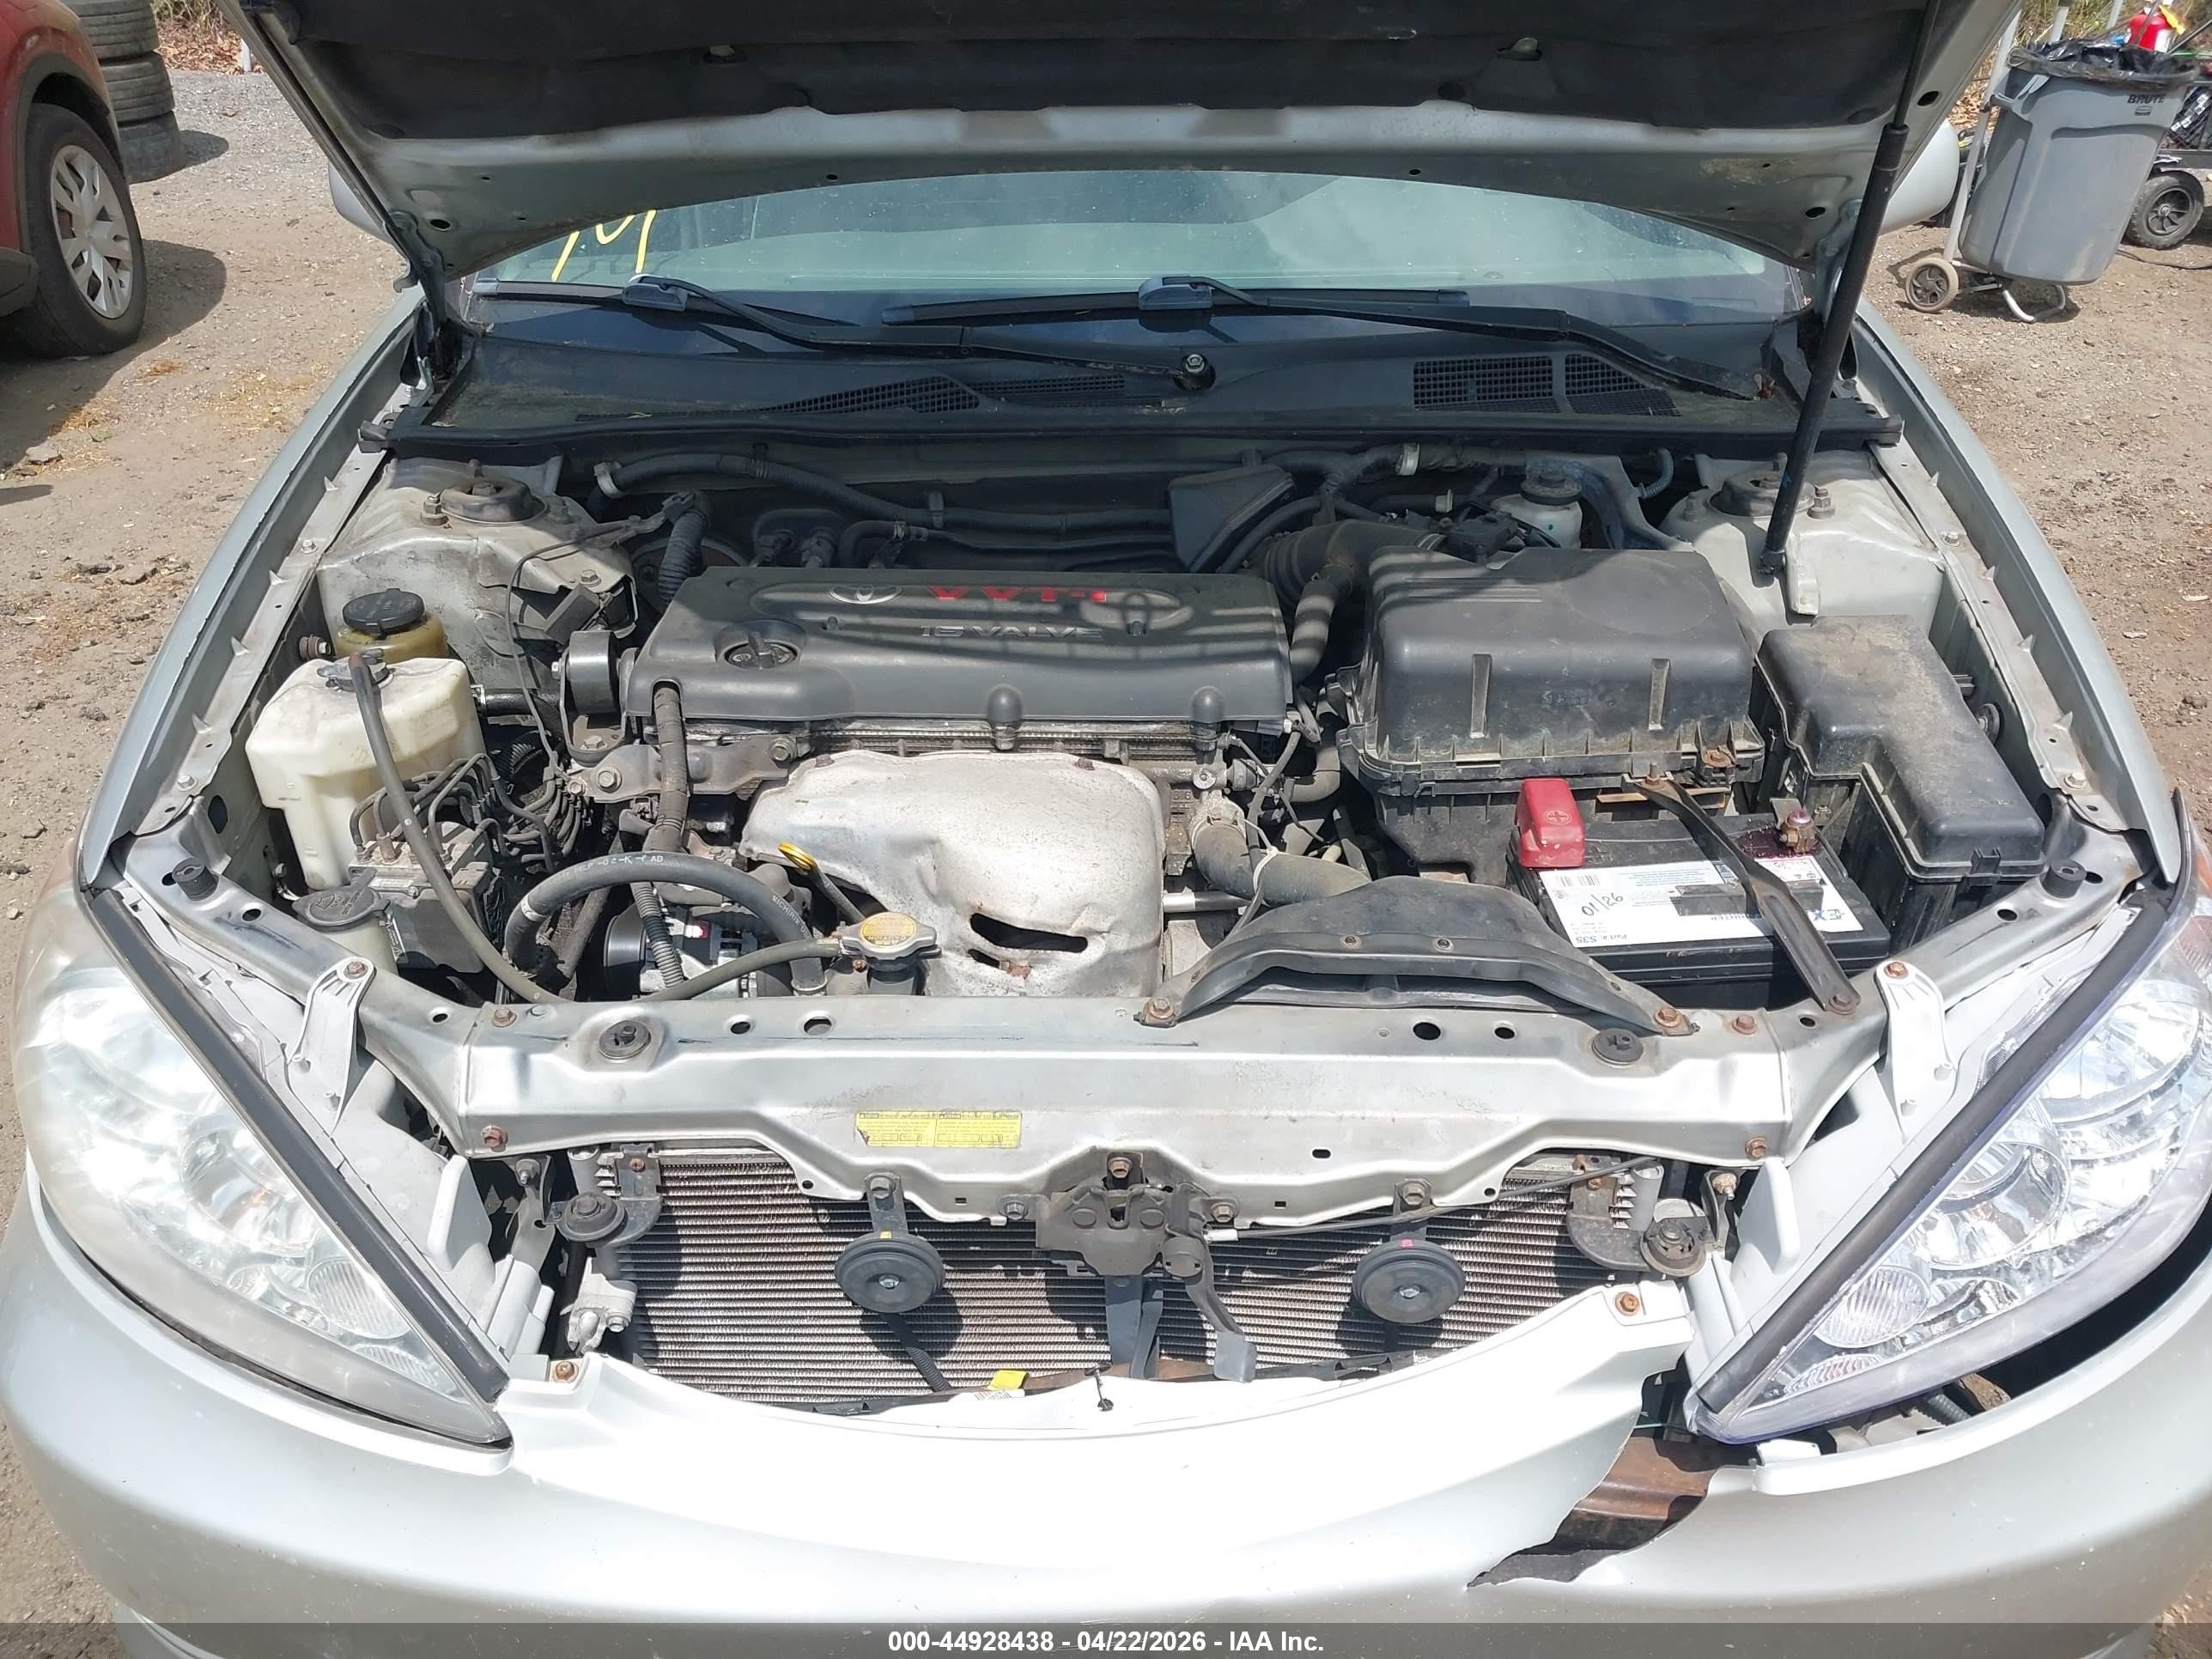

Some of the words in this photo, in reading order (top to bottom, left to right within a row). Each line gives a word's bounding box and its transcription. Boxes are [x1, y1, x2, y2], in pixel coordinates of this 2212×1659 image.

[2127, 94, 2165, 104] BRUTE
[972, 625, 1103, 638] VALVE
[1582, 893, 1623, 916] 01/26
[1576, 935, 1597, 944] S35
